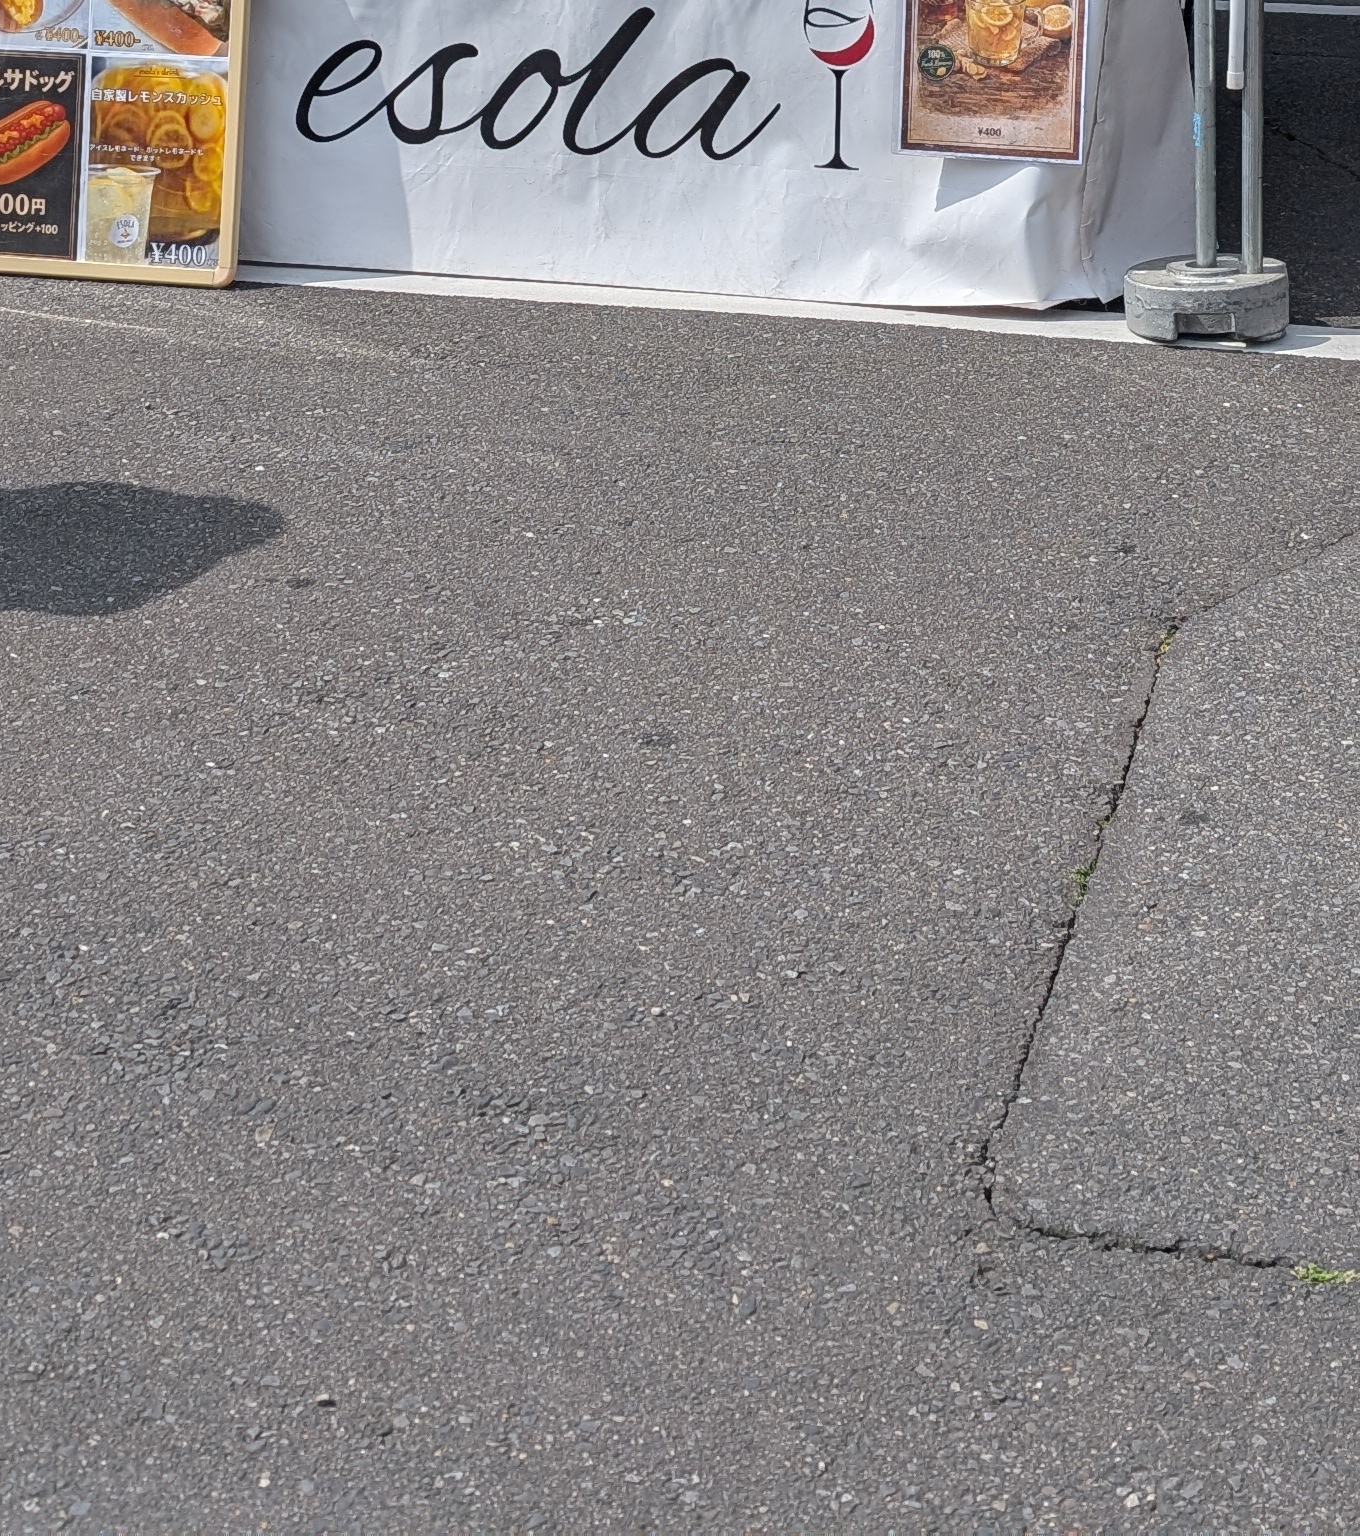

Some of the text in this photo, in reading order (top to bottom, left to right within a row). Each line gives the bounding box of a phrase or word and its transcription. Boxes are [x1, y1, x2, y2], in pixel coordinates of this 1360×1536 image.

[93, 29, 142, 48] ¥400-
[294, 5, 782, 162] esola
[91, 88, 223, 106] 自家製レモンスカッシュ
[977, 127, 1002, 138] ¥400
[150, 241, 208, 267] ¥400
